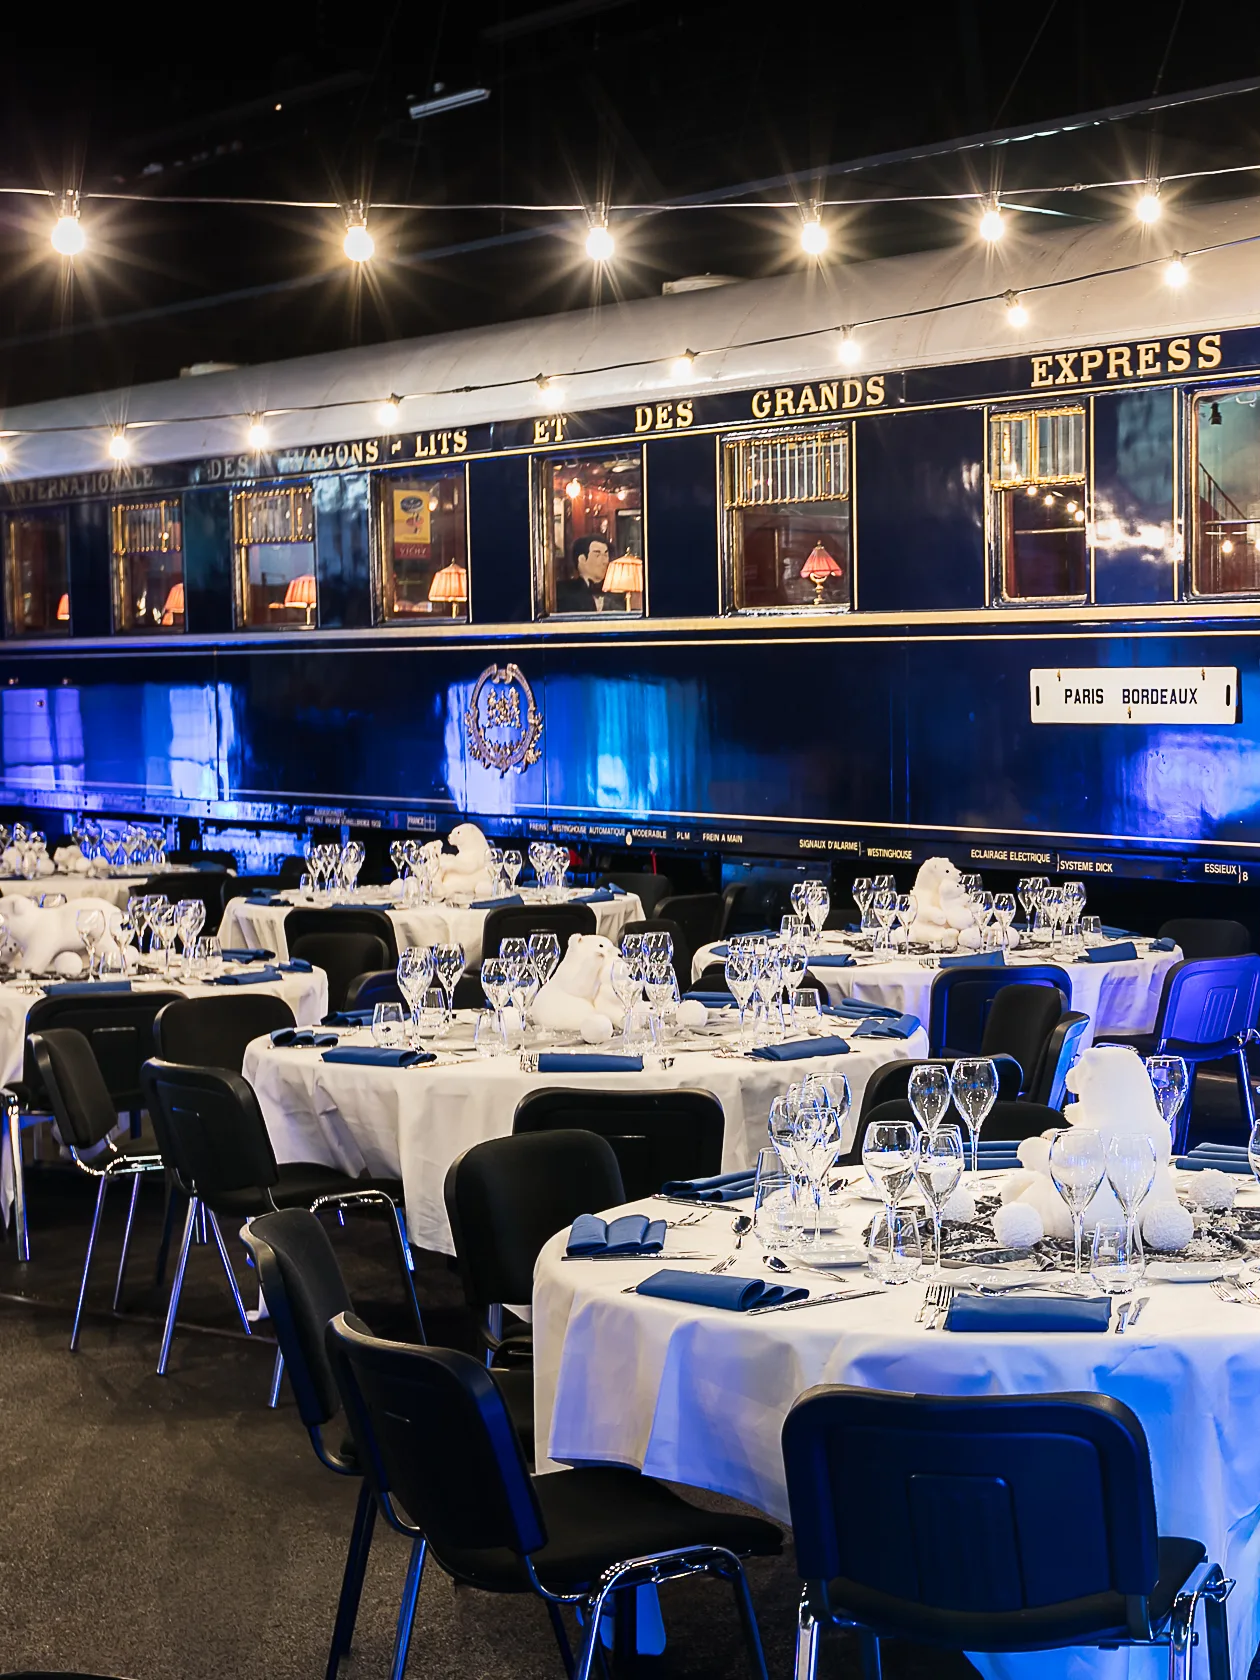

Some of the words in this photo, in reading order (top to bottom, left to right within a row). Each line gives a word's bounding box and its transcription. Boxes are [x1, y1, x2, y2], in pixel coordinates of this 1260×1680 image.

[208, 456, 249, 481] DES
[284, 439, 379, 472] WAGONS
[414, 430, 469, 458] LITS
[533, 417, 567, 445] ET
[635, 400, 694, 433] DES
[752, 376, 886, 418] GRANDS
[1030, 334, 1222, 388] EXPRESS
[1064, 688, 1104, 704] PARIS
[1122, 688, 1198, 704] BORDEAUX
[552, 824, 587, 834] WESTINGHOUSE
[589, 826, 626, 836] AUTOMATIQUE
[632, 829, 667, 839] MODERABLE
[676, 832, 690, 840] PLM
[702, 833, 720, 842] FREIN
[727, 834, 743, 843] MAIN
[799, 839, 826, 849] SIGNAUX
[827, 841, 858, 850] D'ALARME
[867, 848, 912, 859] WESTINGHOUSE
[971, 849, 1008, 860] ECLAIRAGE
[1010, 852, 1051, 864] ELECTRIQUE
[1060, 860, 1093, 872] SYSTEME
[1095, 863, 1113, 873] DICK
[1204, 863, 1237, 875] ESSIEUX
[1242, 871, 1249, 881] 8
